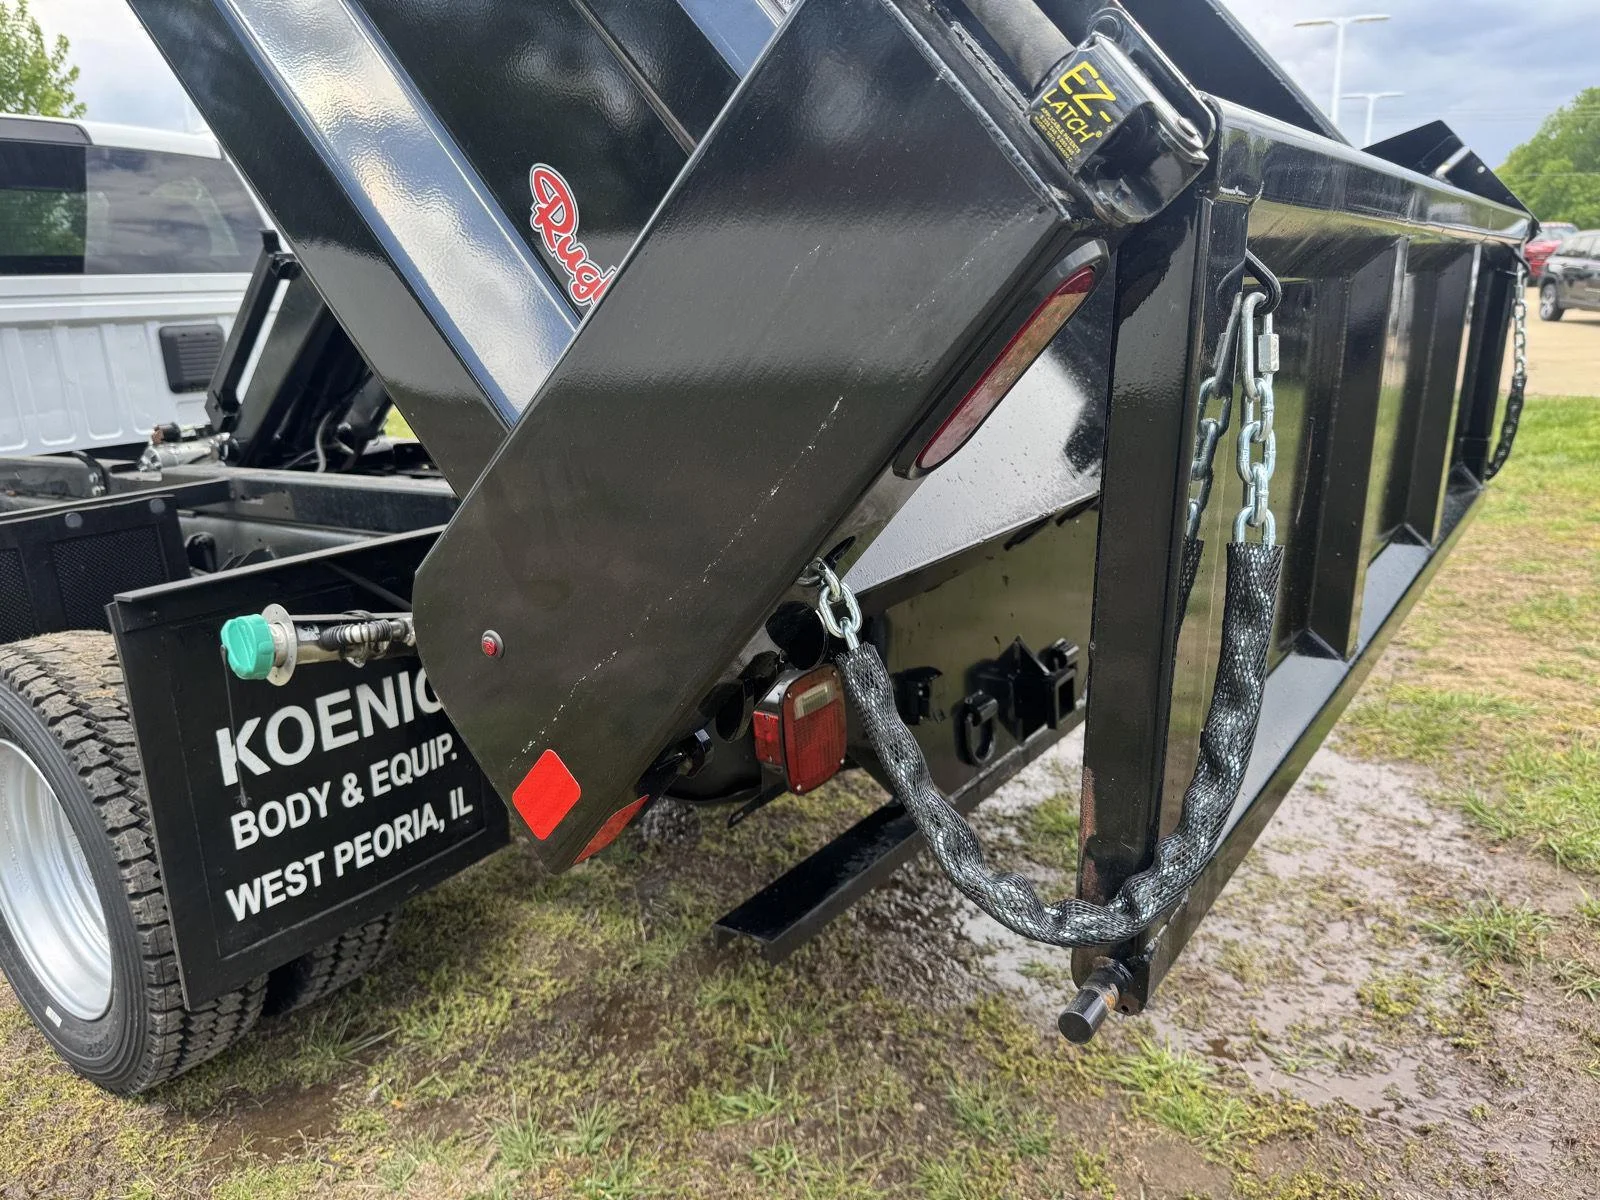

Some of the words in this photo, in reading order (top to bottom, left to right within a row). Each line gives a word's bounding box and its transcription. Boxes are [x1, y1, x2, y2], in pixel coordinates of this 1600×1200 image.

[225, 852, 325, 922] WEST
[334, 803, 445, 877] PEORIA,
[449, 787, 473, 820] IL
[230, 781, 331, 850] BODY
[341, 772, 364, 808] &
[370, 733, 457, 797] EQUIP.
